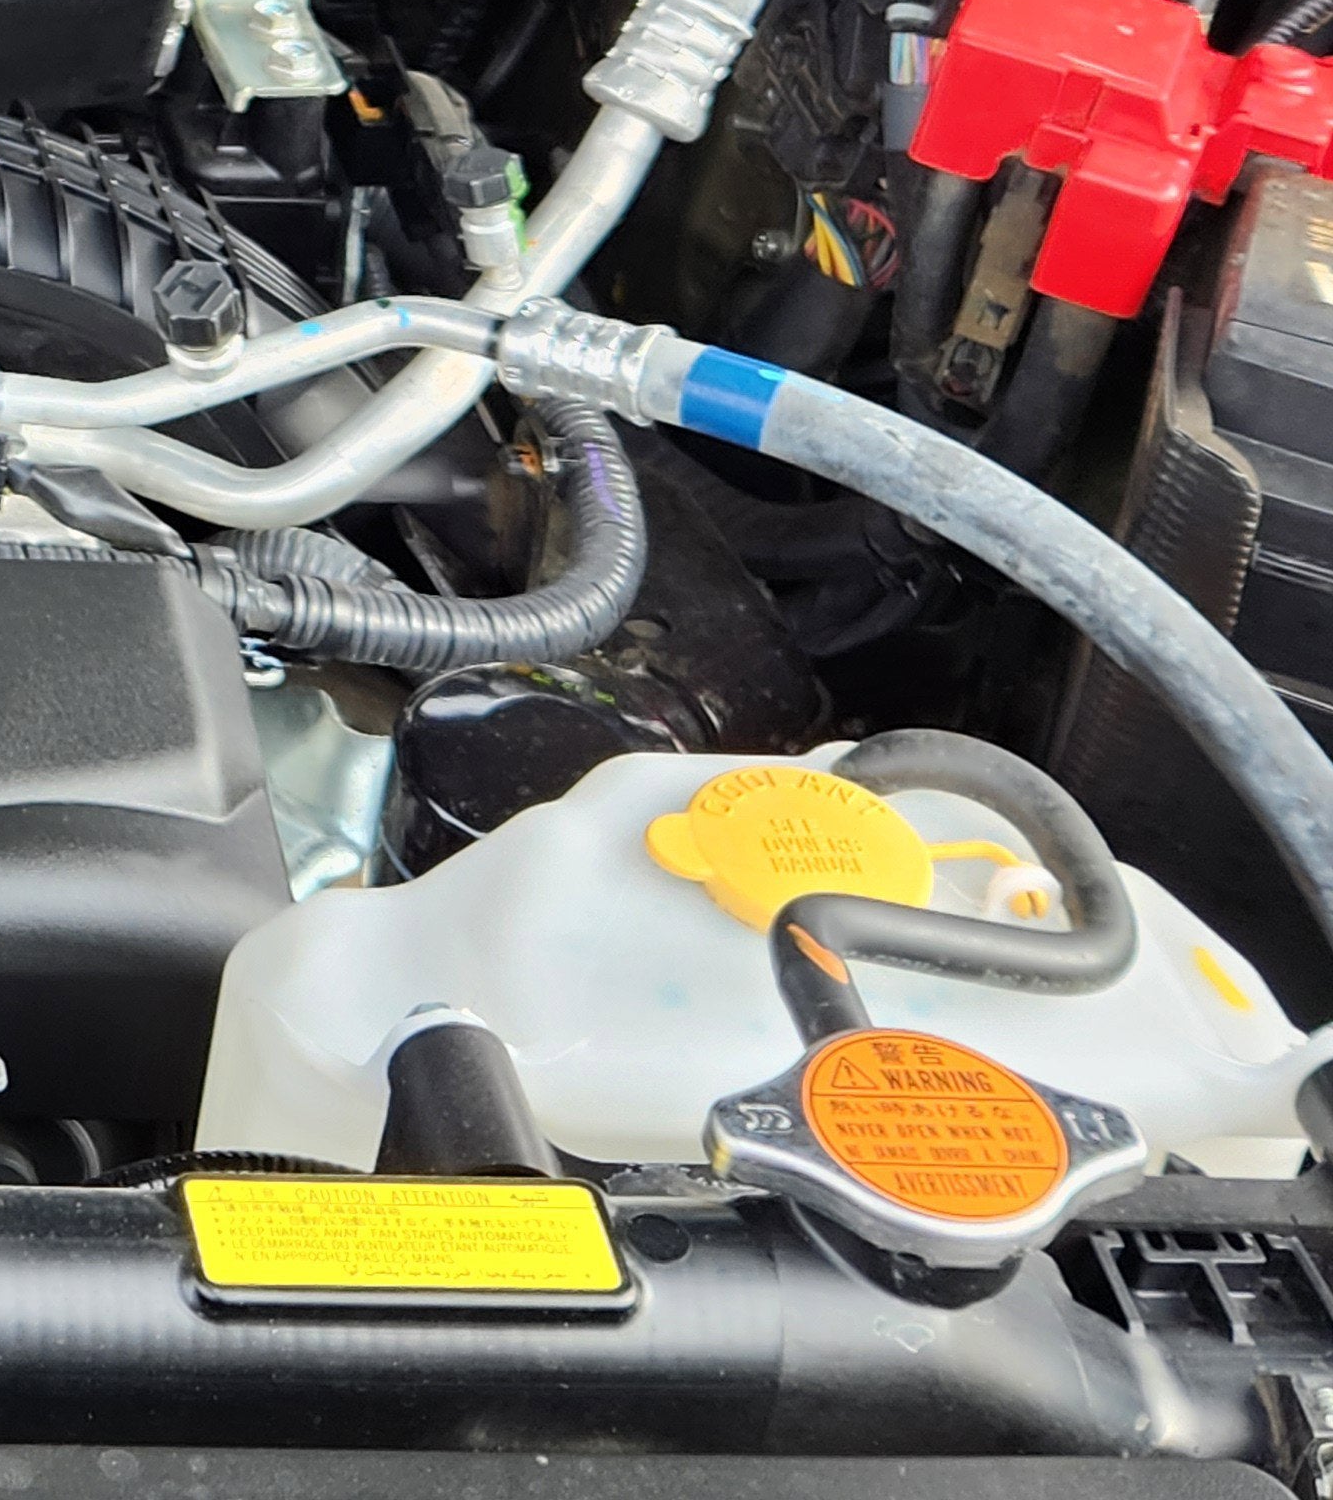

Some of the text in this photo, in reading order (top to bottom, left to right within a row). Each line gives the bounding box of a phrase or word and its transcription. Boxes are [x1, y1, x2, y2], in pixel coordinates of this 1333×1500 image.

[871, 1041, 945, 1066] 警告
[879, 1068, 995, 1094] WARNING
[835, 1122, 886, 1139] NEVER
[896, 1123, 940, 1140] OPEN
[947, 1124, 994, 1141] WHEN
[294, 1187, 377, 1205] CAUTION
[391, 1189, 491, 1206] ATTENTION
[229, 1226, 266, 1238] KEEP
[270, 1226, 320, 1239] HANDS
[370, 1228, 398, 1240] FAN
[403, 1229, 455, 1242] STARTS
